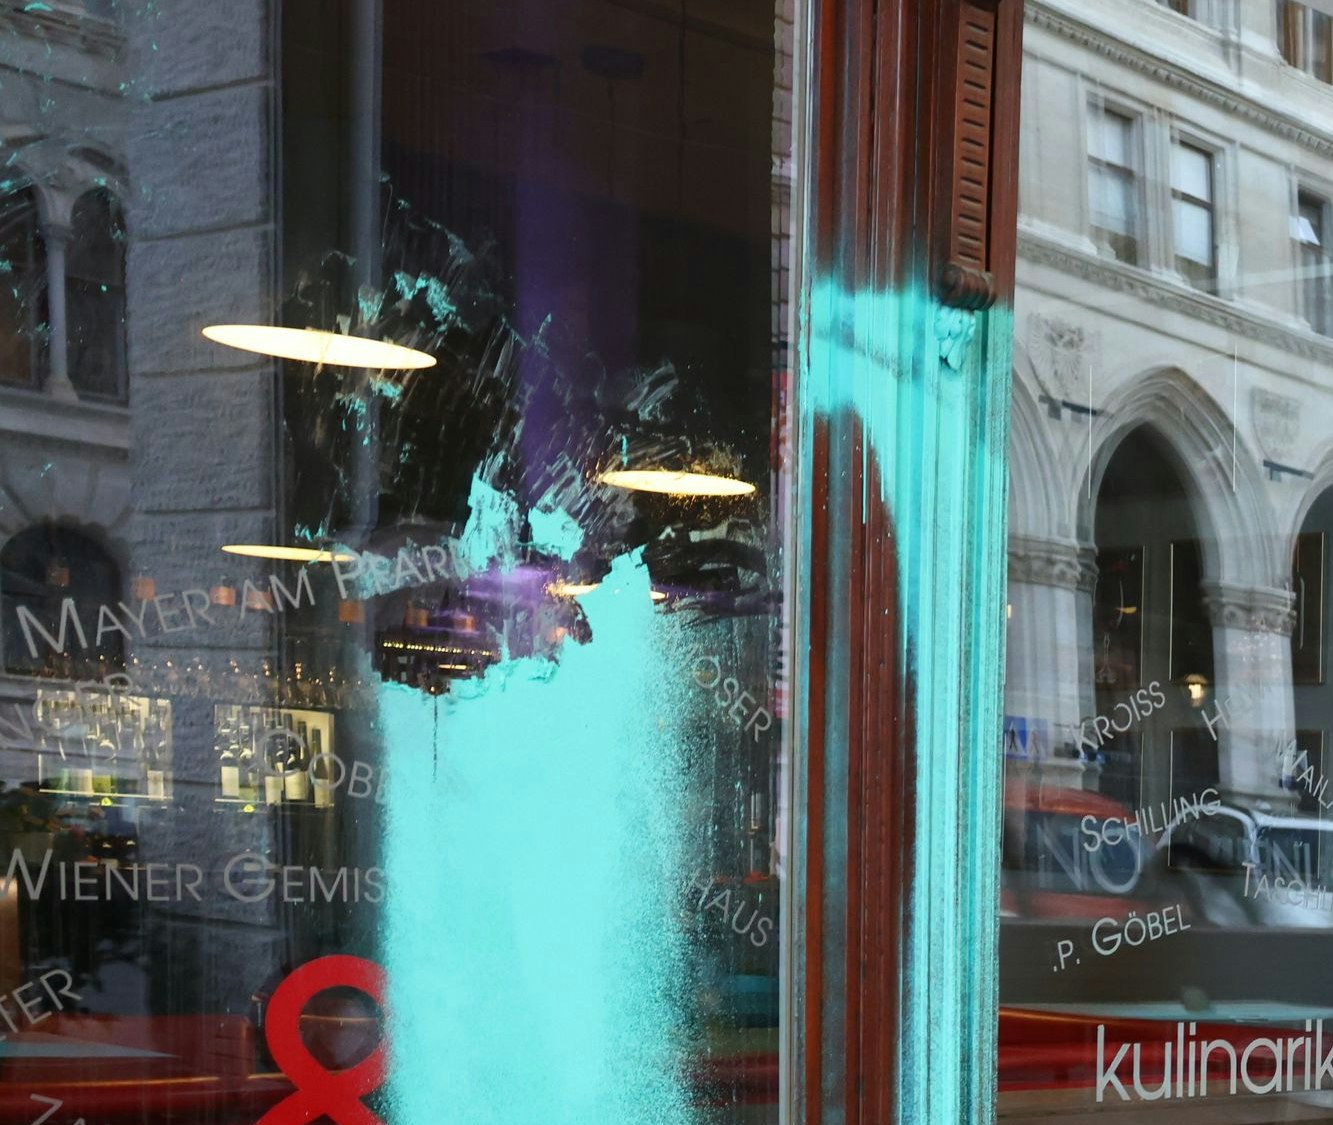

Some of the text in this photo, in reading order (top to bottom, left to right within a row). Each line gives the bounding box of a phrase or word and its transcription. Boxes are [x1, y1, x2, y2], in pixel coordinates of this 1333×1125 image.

[16, 588, 214, 659] MAYER
[239, 572, 316, 619] AM
[1070, 680, 1166, 757] KROISS
[1081, 787, 1221, 853] SCHILLING
[0, 848, 203, 901] WIENER
[1091, 903, 1192, 956] GÖBEL
[0, 968, 84, 1040] TER
